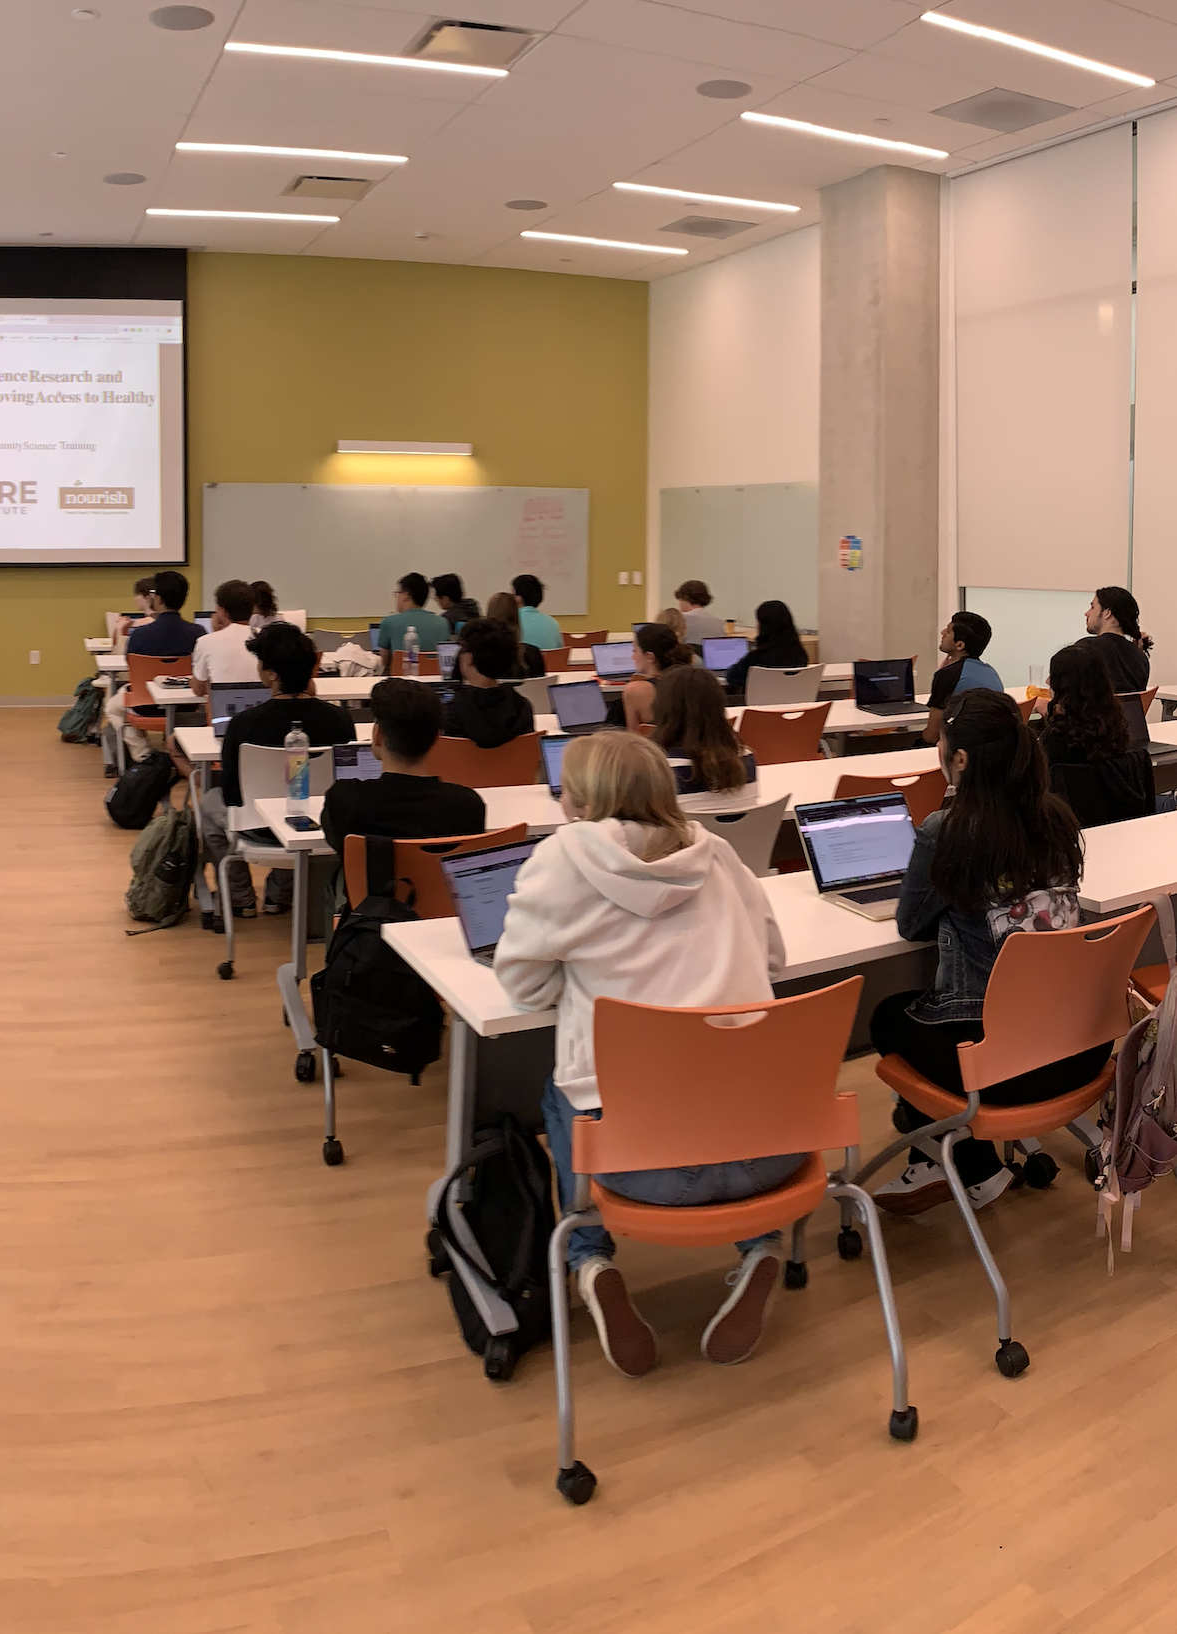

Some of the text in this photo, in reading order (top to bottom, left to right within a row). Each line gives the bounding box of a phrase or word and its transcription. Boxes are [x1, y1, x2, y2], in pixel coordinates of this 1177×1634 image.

[29, 370, 93, 383] Research
[96, 371, 123, 383] and
[36, 391, 82, 403] Access
[85, 391, 99, 403] to
[102, 391, 157, 406] Healthy
[23, 441, 58, 450] Science
[59, 441, 98, 452] Training
[65, 490, 128, 504] nourish
